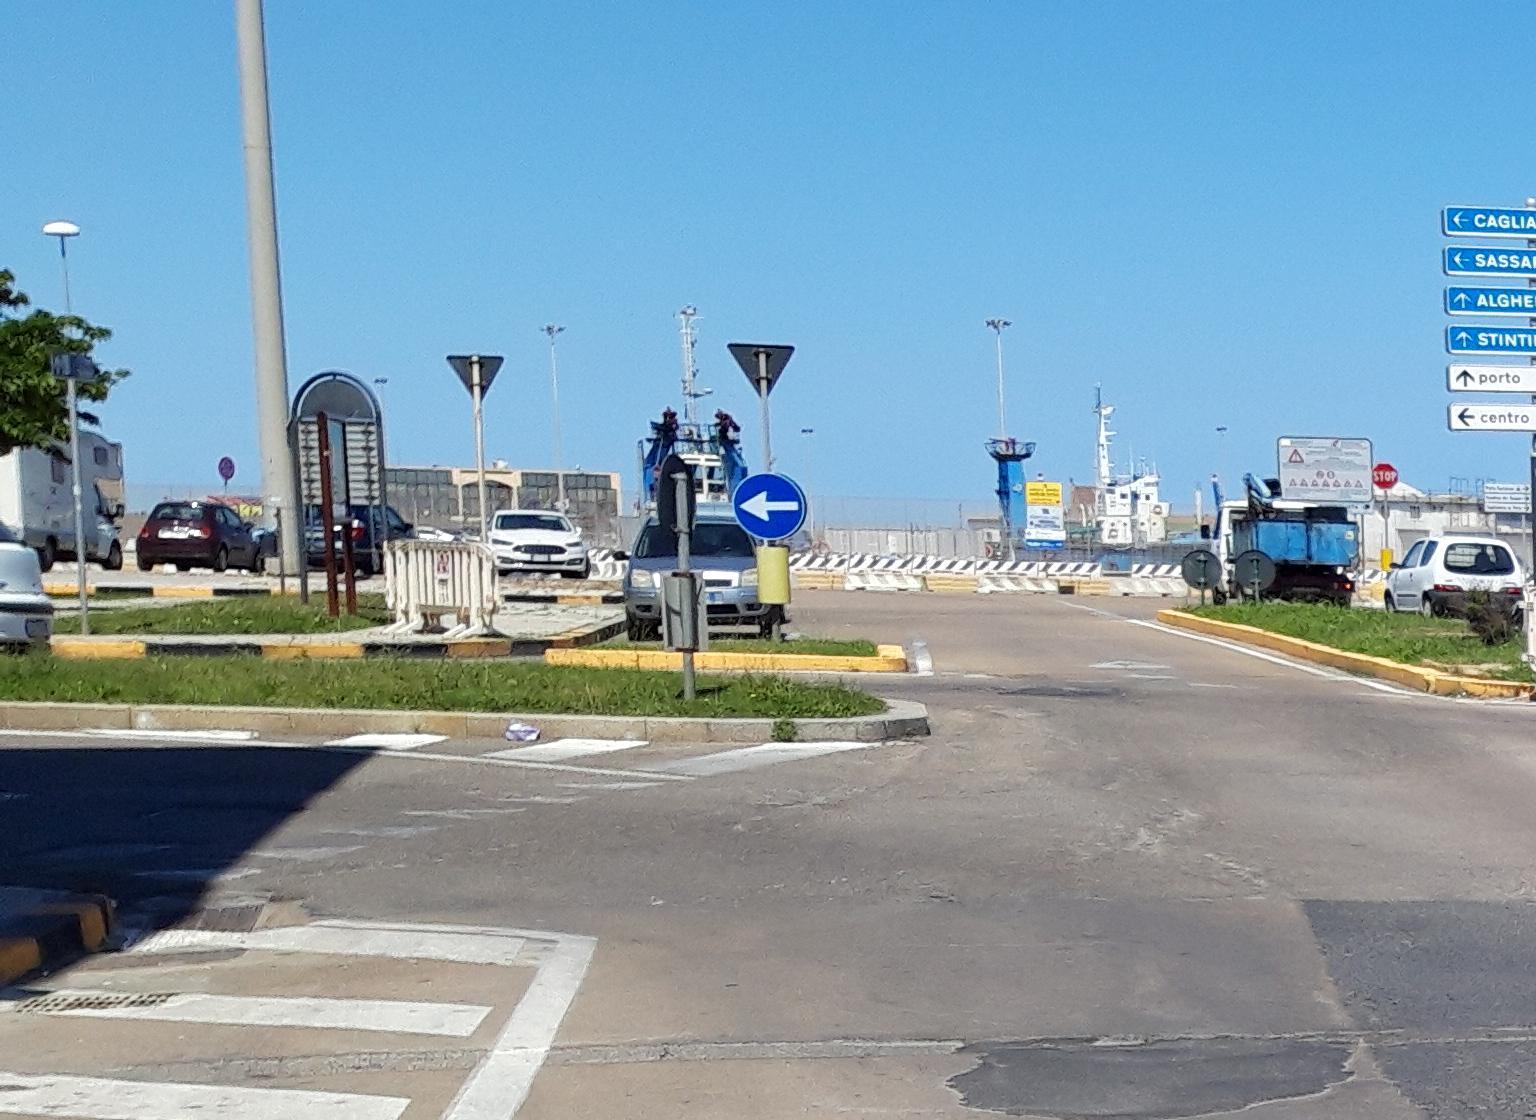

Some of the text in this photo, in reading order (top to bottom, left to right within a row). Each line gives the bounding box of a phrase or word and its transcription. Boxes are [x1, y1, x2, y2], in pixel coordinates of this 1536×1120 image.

[1479, 371, 1521, 386] porto
[1480, 408, 1530, 424] centro
[1373, 471, 1397, 482] STOP
